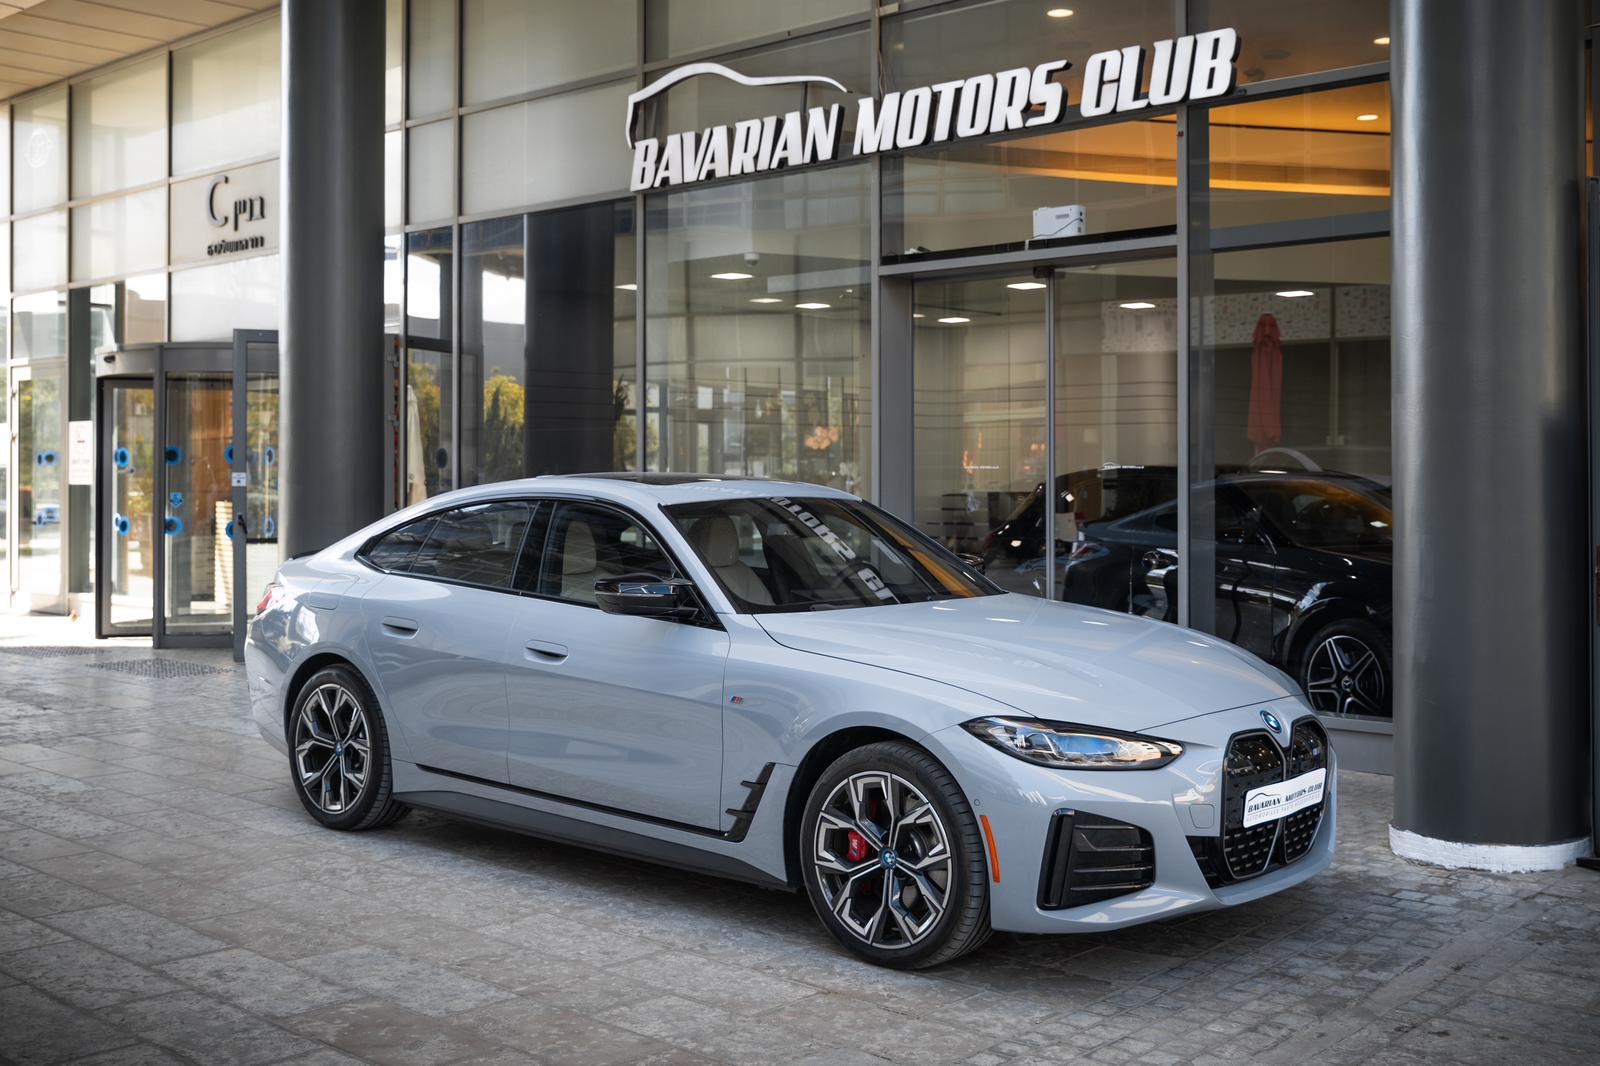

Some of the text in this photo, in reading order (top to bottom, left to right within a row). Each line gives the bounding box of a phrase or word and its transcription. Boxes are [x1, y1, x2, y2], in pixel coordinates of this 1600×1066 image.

[630, 27, 1241, 192] BAVARIAN MOTORS CLUB
[207, 174, 229, 227] C
[1247, 798, 1281, 813] BAVARIAN
